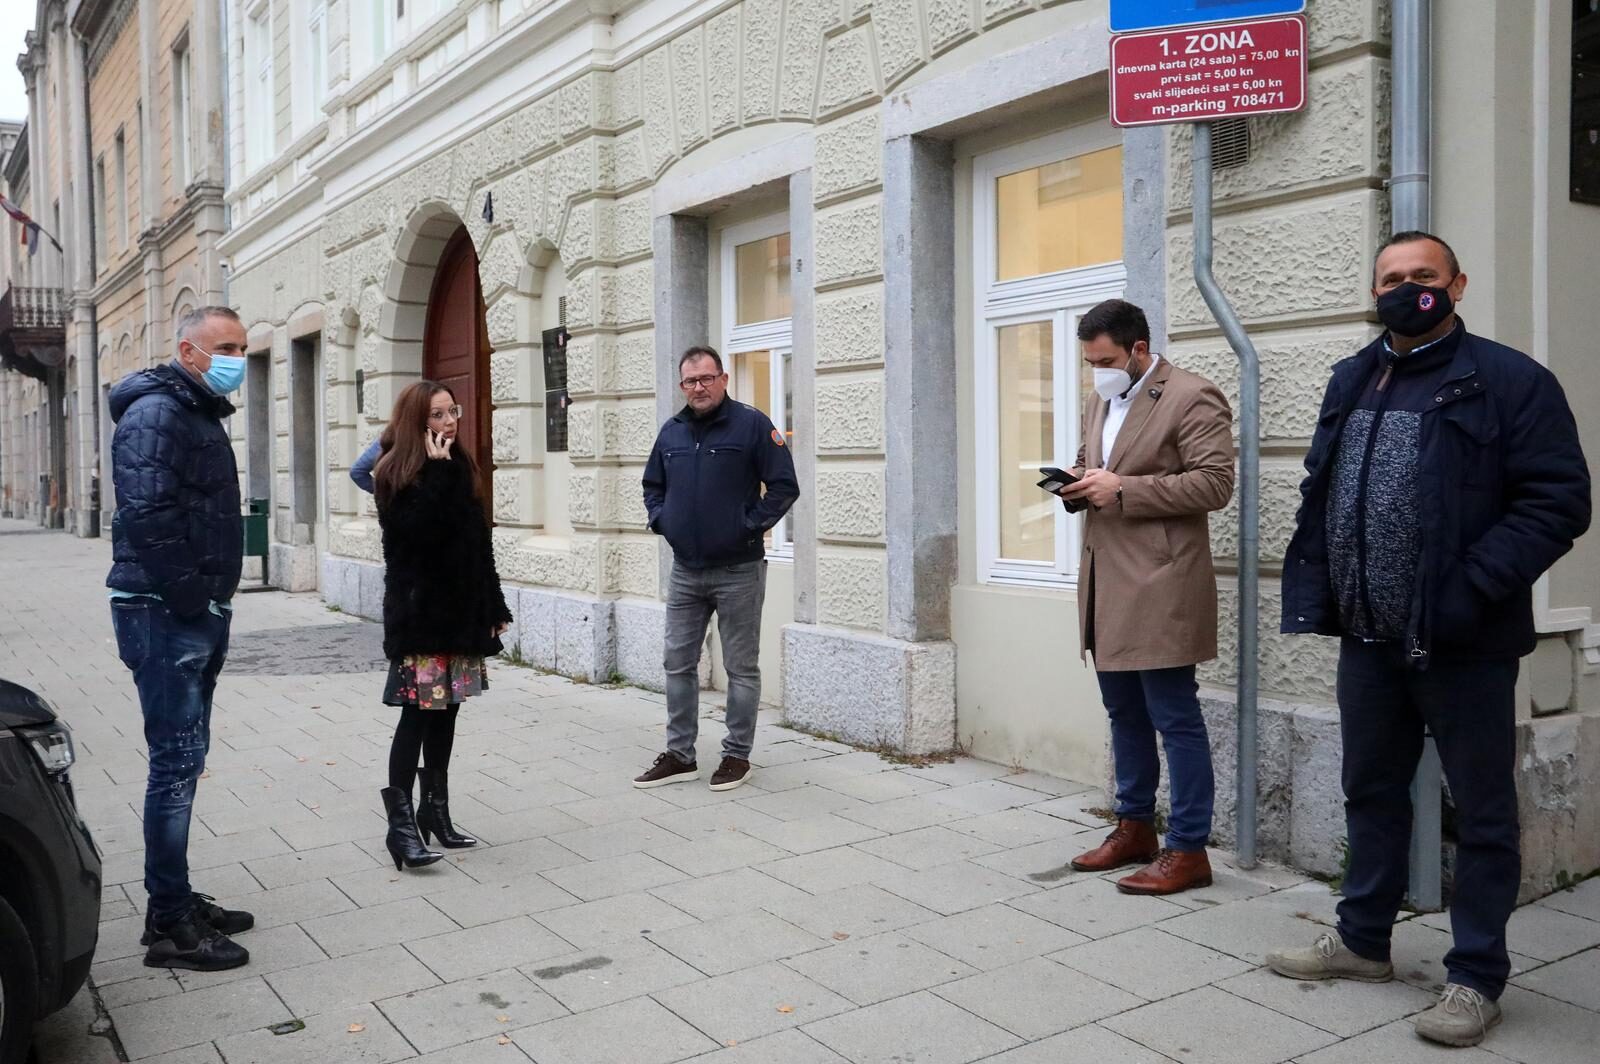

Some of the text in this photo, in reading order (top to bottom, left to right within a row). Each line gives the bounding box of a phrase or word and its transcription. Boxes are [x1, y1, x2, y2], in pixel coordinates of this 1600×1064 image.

[1160, 29, 1255, 56] 1. ZONA
[1117, 64, 1156, 74] dnevna
[1159, 60, 1187, 70] karta
[1189, 57, 1206, 69] (24
[1209, 54, 1237, 65] sata)
[1250, 50, 1279, 61] 75,00
[1285, 48, 1299, 57] kn
[1133, 89, 1162, 100] svaki
[1164, 84, 1210, 98] slijedeći
[1213, 83, 1230, 93] sat
[1242, 80, 1265, 91] 6,00
[1268, 78, 1282, 87] kn
[1161, 74, 1182, 86] prvi
[1184, 72, 1201, 82] sat
[1214, 68, 1236, 79] 5,00
[1240, 67, 1253, 76] kn
[1152, 91, 1284, 116] m-parking 708471
